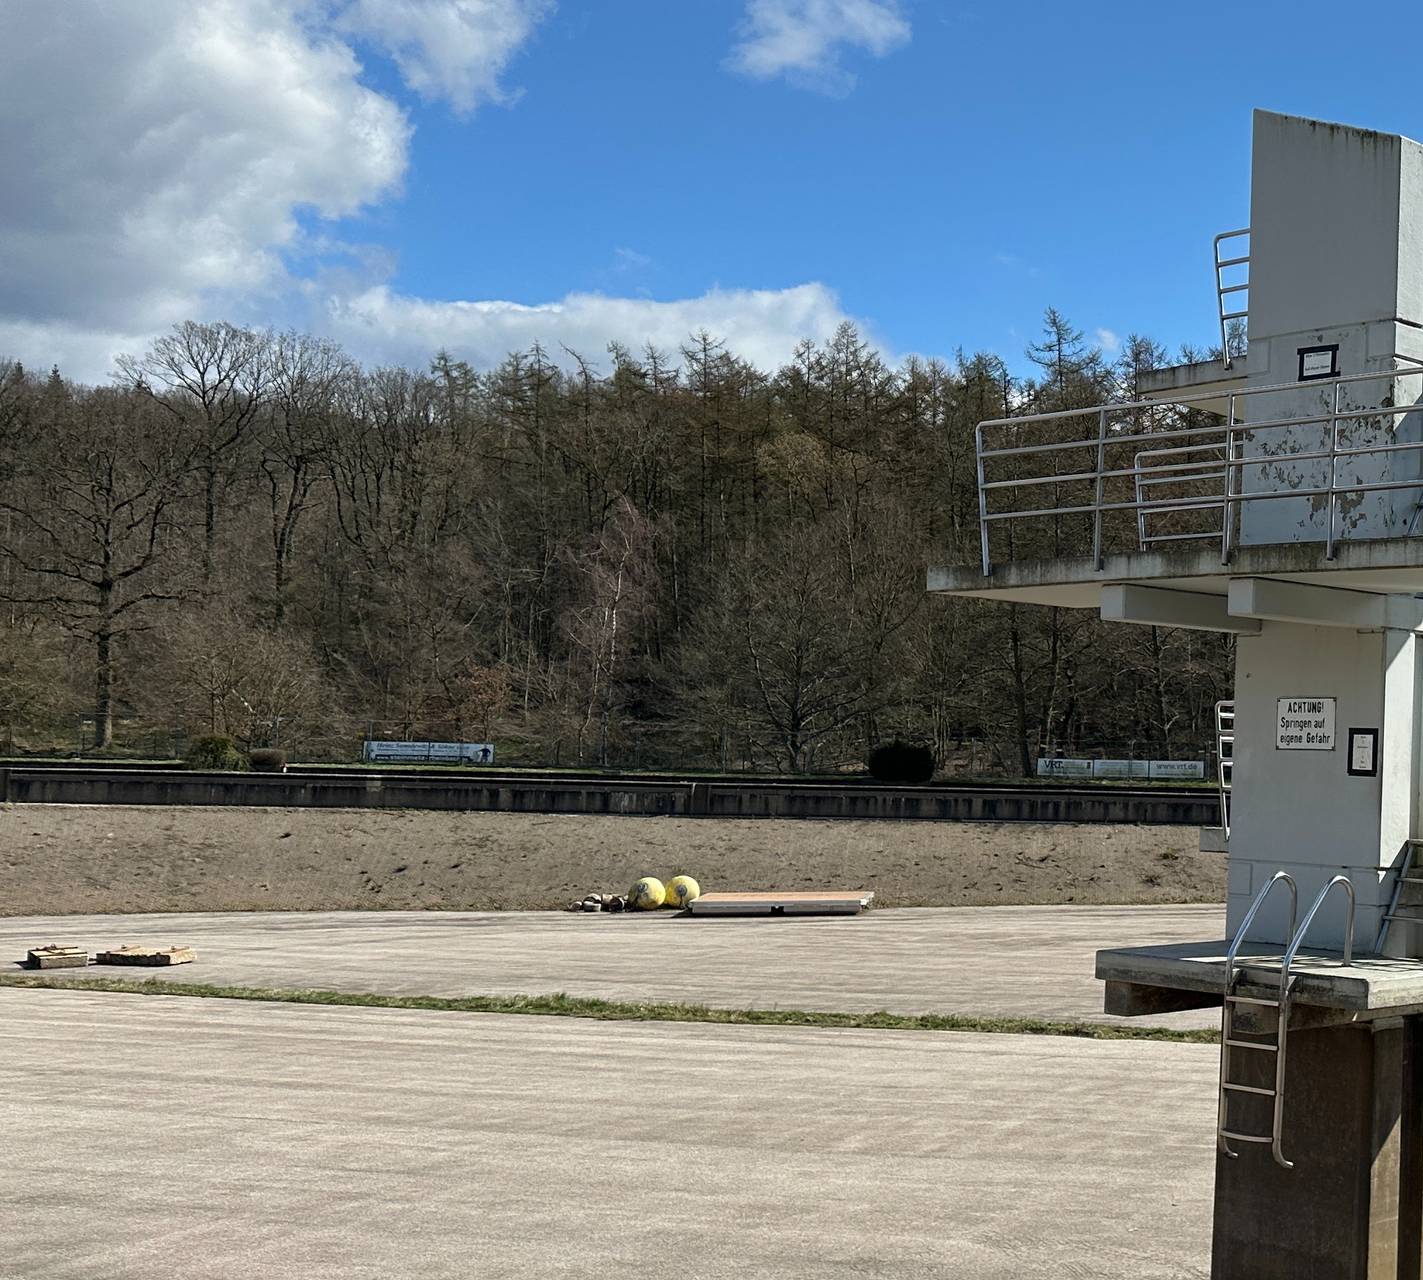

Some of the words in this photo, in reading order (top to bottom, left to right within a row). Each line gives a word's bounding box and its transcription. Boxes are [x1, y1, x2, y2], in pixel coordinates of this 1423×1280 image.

[1287, 701, 1325, 714] ACHTUNG!
[1280, 716, 1312, 731] Springen
[1313, 717, 1326, 729] auf
[1280, 734, 1303, 746] eigene
[1306, 732, 1331, 744] Gefahr
